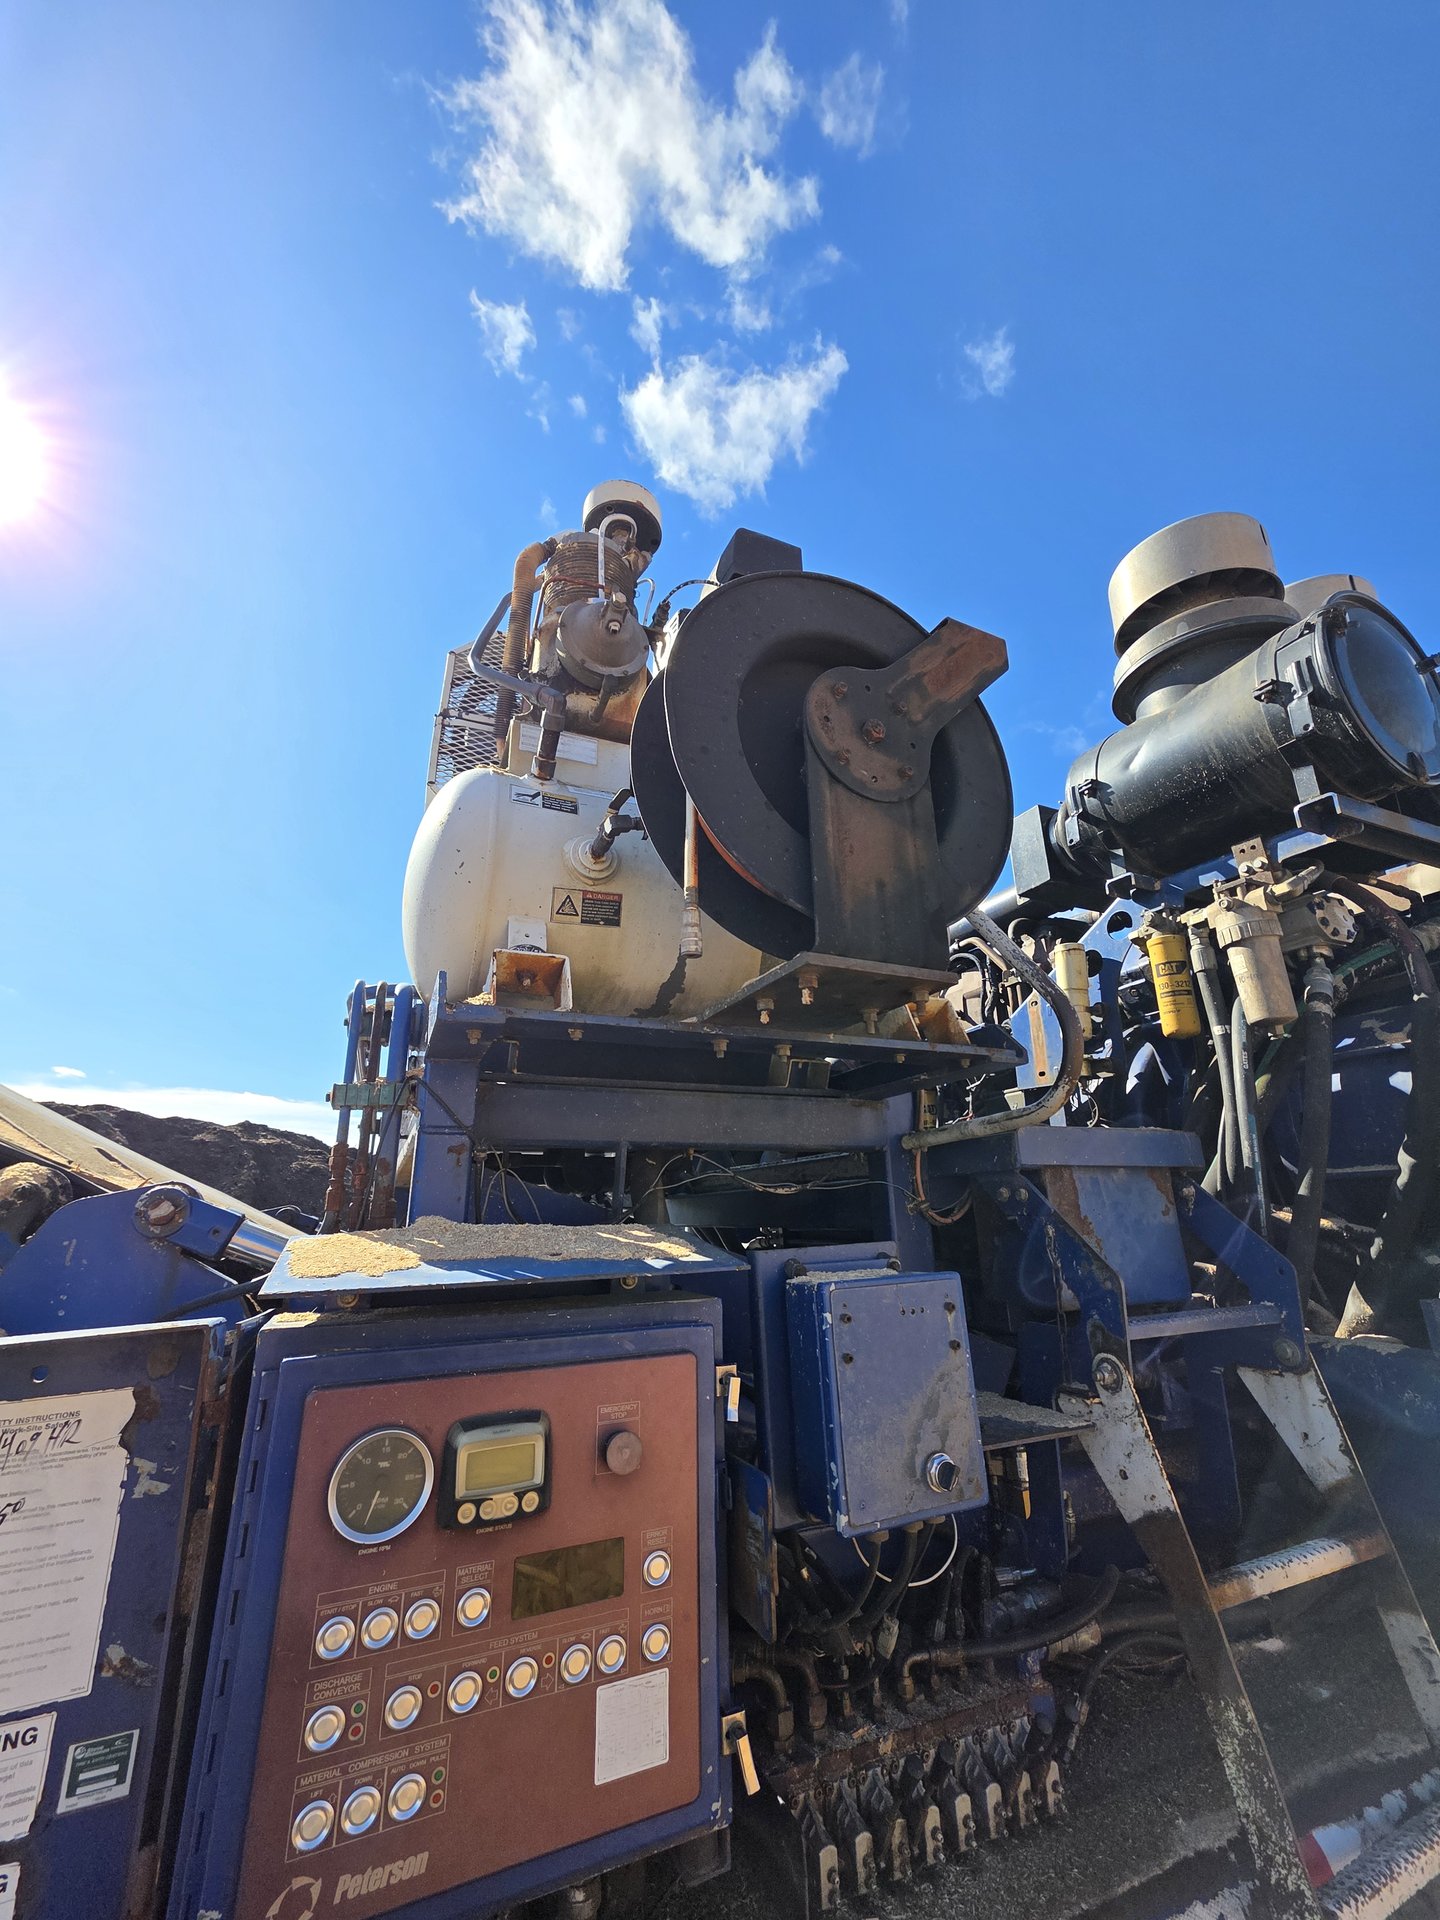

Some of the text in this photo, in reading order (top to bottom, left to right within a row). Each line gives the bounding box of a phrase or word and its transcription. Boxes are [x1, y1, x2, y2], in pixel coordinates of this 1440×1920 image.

[1160, 962, 1177, 975] CAT
[600, 1403, 639, 1414] EMERGENCY
[15, 1410, 81, 1424] INSTRUCTIONS
[610, 1411, 628, 1420] STOP
[476, 1522, 513, 1535] ENGINE STATUS
[646, 1529, 667, 1539] ERROR
[648, 1537, 667, 1545] RESET
[358, 1544, 392, 1555] ENGINE RPM
[457, 1562, 493, 1577] MATERIAL
[461, 1572, 489, 1584] SELECT
[368, 1582, 399, 1595] ENGINE
[410, 1590, 424, 1598] FAST
[367, 1598, 384, 1607] SLOW
[320, 1606, 338, 1616] START
[341, 1604, 357, 1613] STOP
[644, 1607, 663, 1616] HORN
[599, 1627, 611, 1635] FAST
[489, 1631, 539, 1649] FEED SYSTEM
[562, 1635, 576, 1644] SLOW
[462, 1657, 488, 1668] FORWARD
[313, 1673, 363, 1692] DISCHARGE
[408, 1673, 423, 1682] STOP
[313, 1683, 361, 1701] CONVEYOR
[300, 1739, 447, 1786] MATERIAL COMPRESSION SYSTEM
[390, 1752, 448, 1774] AUTO DOWN PULSE
[354, 1775, 373, 1786] DOWN
[310, 1789, 324, 1798] LIFT
[333, 1851, 430, 1906] Peterson
